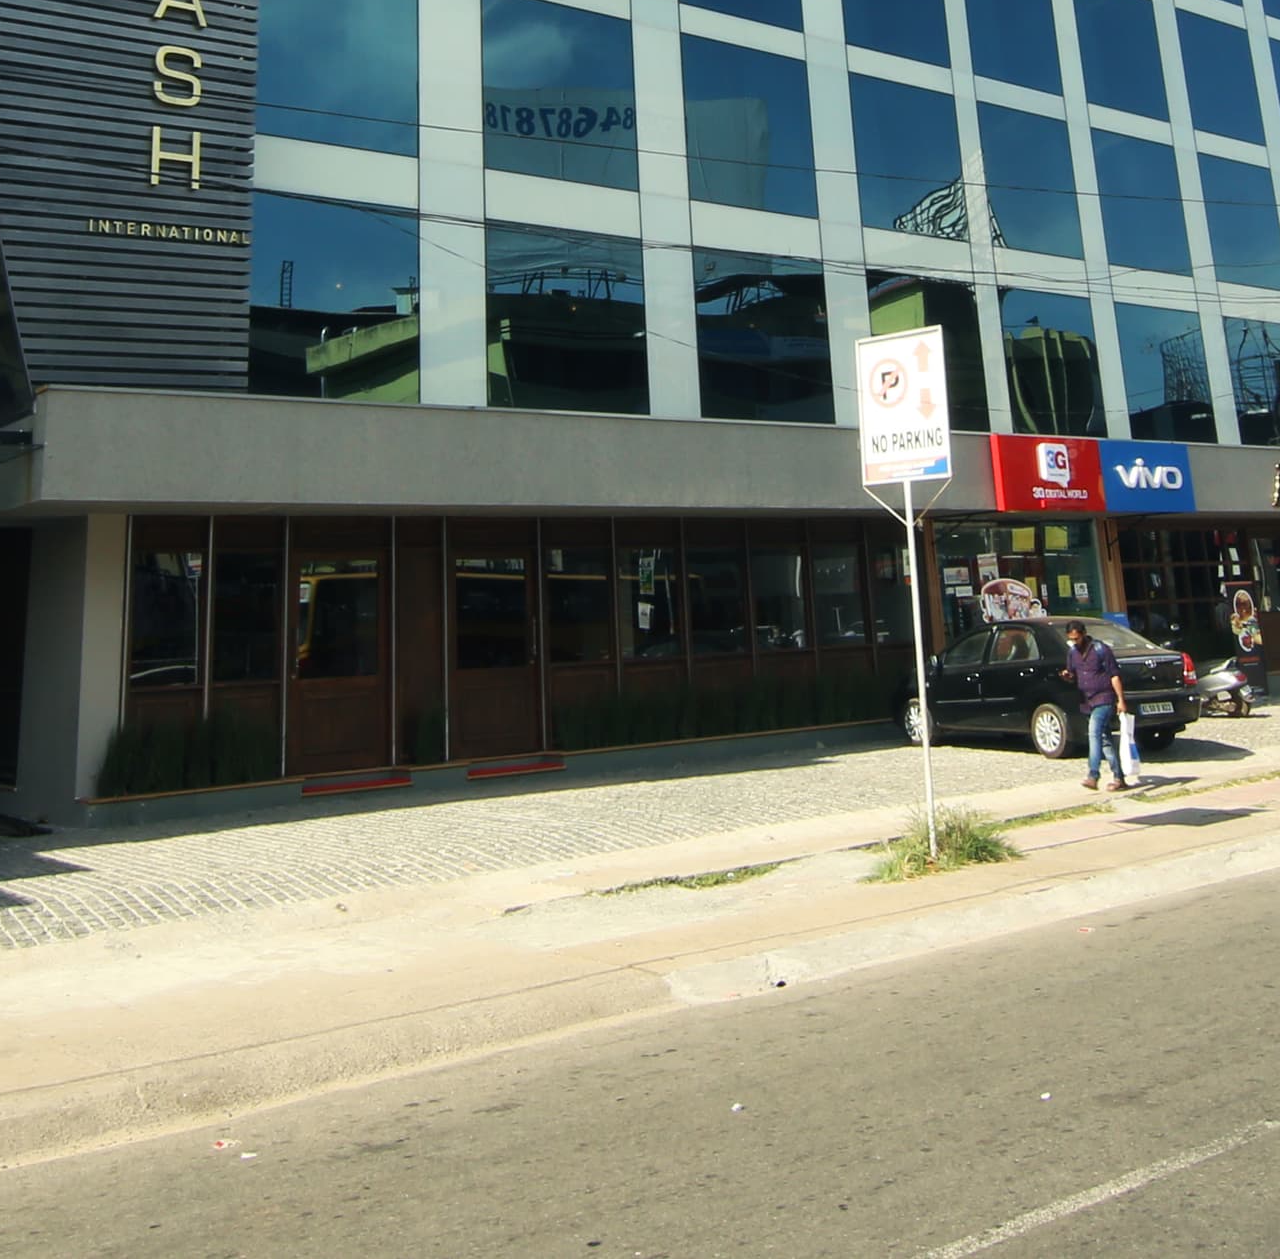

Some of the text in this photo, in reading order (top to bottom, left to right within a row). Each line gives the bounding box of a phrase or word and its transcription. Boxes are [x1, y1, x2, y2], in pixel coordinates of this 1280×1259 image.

[88, 218, 250, 245] INTERNATIONAL
[872, 428, 944, 453] NO PARKING
[1046, 450, 1067, 470] 3G
